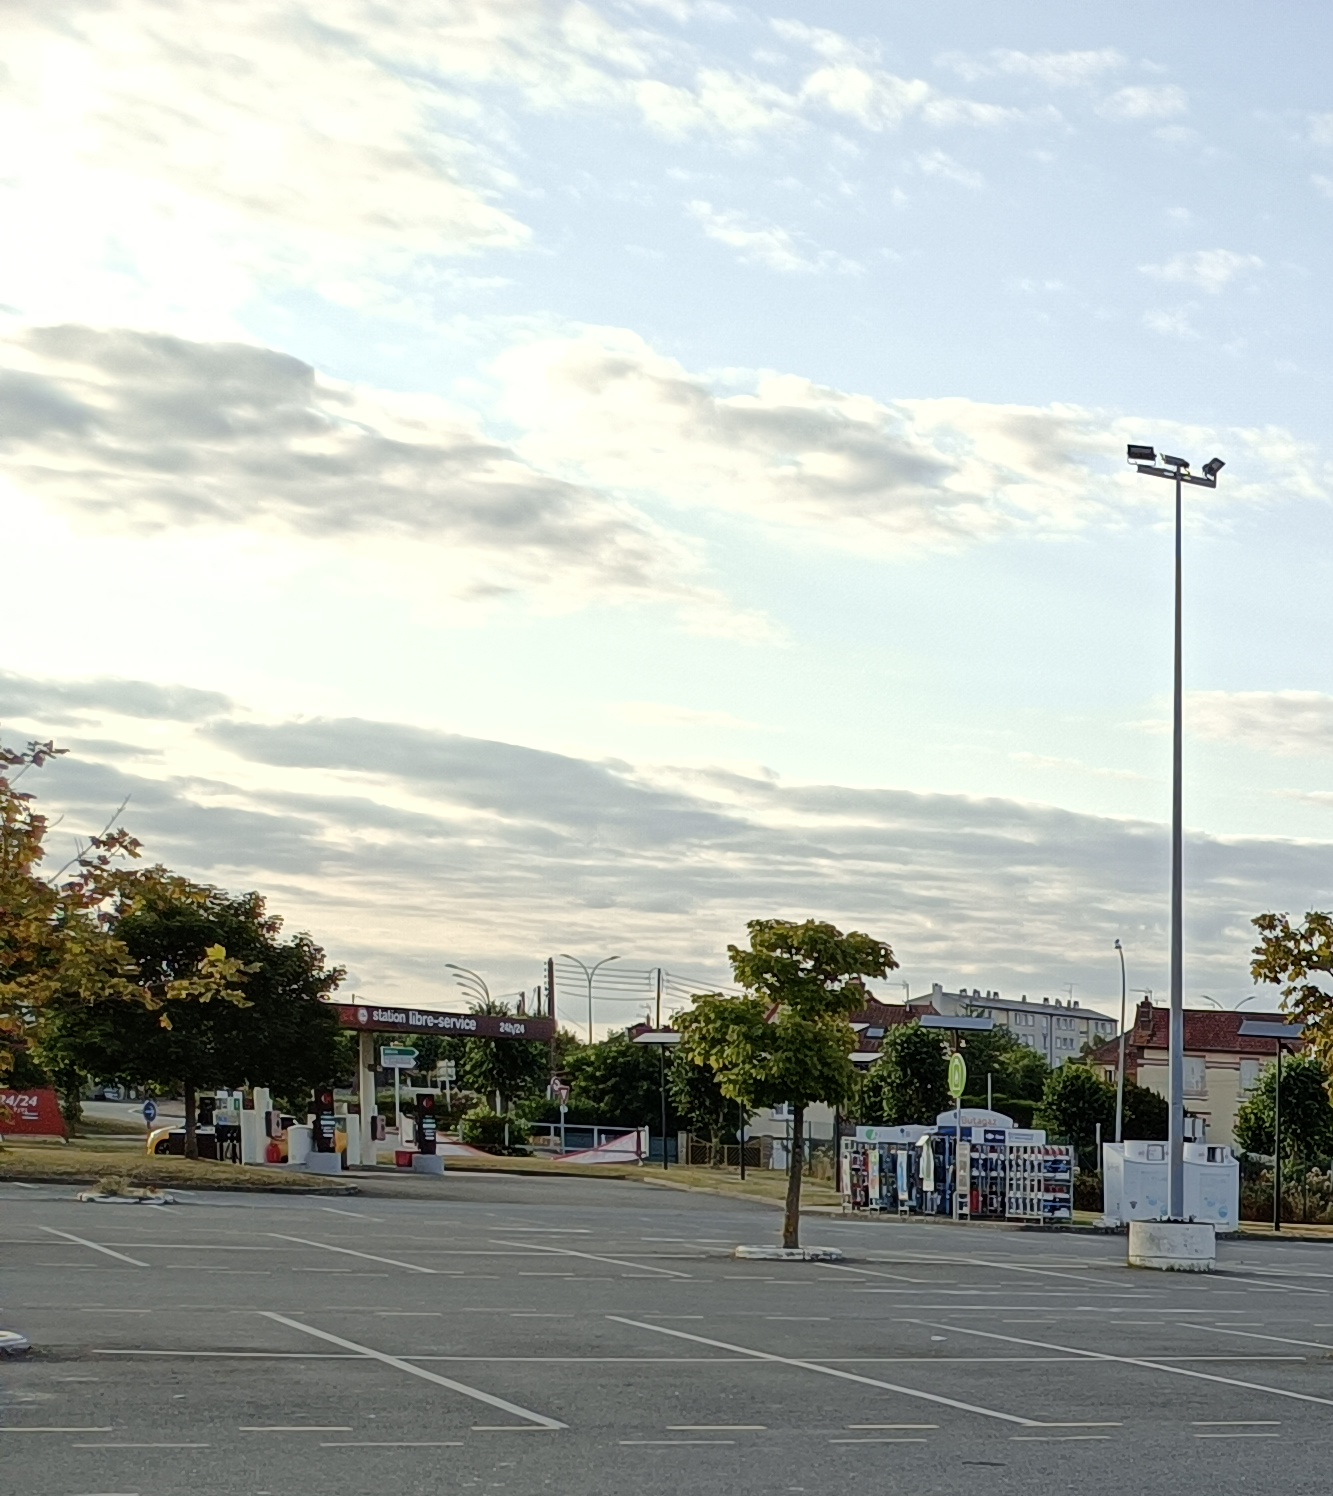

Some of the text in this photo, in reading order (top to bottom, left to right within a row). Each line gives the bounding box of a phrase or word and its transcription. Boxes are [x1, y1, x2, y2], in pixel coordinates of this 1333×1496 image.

[373, 1009, 525, 1036] station libre-service 24h/24
[961, 1116, 997, 1127] Butagaz
